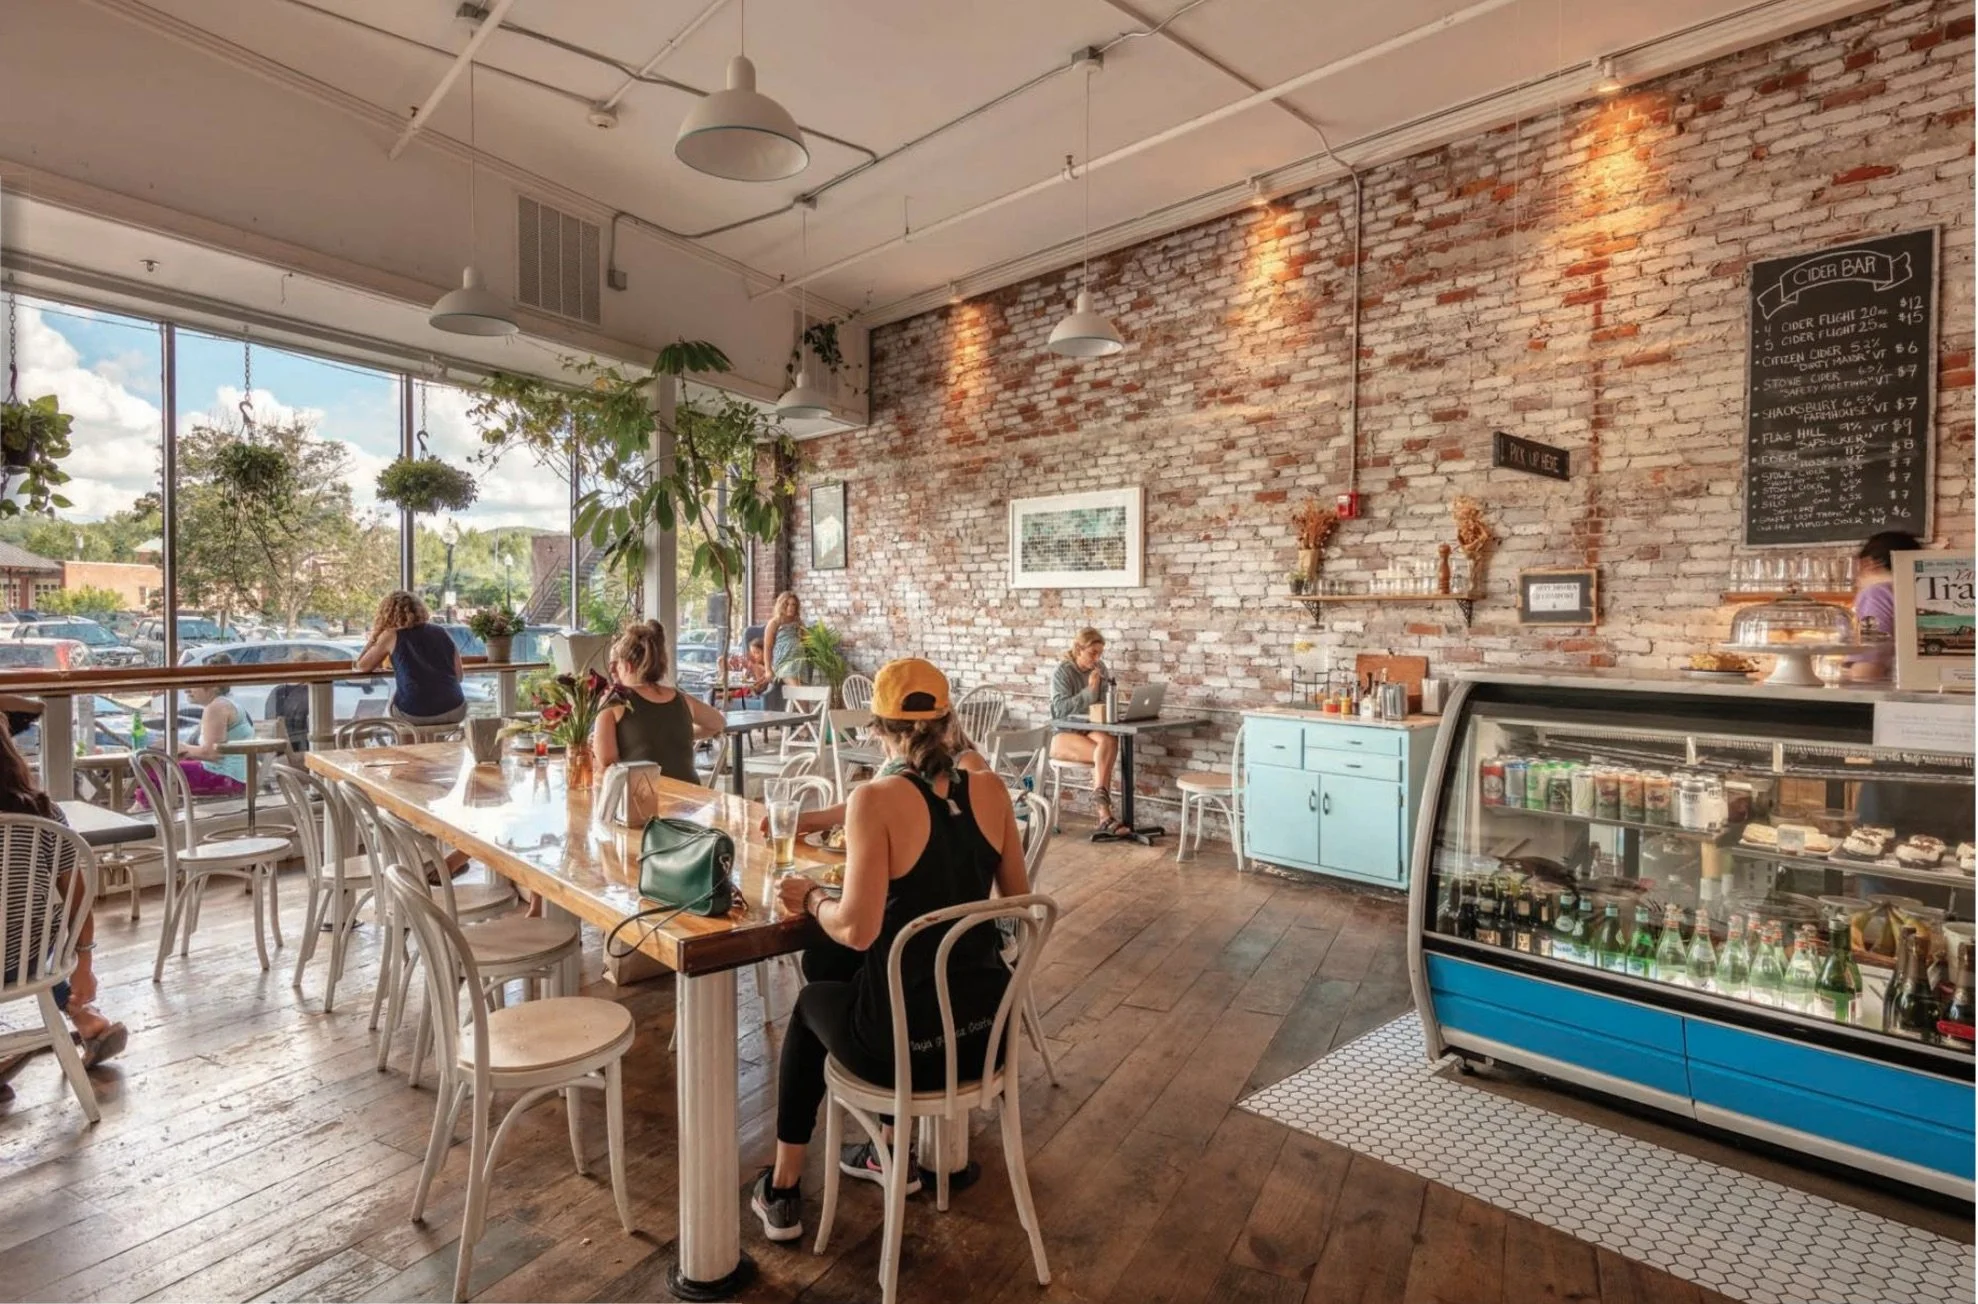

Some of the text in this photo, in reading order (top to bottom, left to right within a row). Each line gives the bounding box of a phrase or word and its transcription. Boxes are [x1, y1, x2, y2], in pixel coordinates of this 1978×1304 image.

[1793, 255, 1877, 285] CIDER BAR
[1781, 317, 1814, 333] CIDER
[1818, 309, 1856, 326] FLIGHT
[1899, 295, 1924, 310] $12
[1764, 339, 1774, 352] 5
[1781, 331, 1815, 346] CIDER
[1818, 323, 1857, 339] FLIGHT
[1897, 310, 1924, 326] $15
[1762, 352, 1805, 368] CITIZEN
[1809, 345, 1842, 360] CIDER
[1895, 340, 1919, 354] $6
[1872, 349, 1888, 360] VT
[1763, 375, 1801, 391] STOWE
[1810, 371, 1841, 384] CIDER
[1897, 364, 1918, 378] $7
[1875, 373, 1893, 386] VT
[1762, 398, 1836, 421] SHACKSBURY
[1896, 397, 1918, 411] $7
[1873, 402, 1889, 413] VT
[1762, 432, 1792, 446] FLAG
[1797, 427, 1826, 440] HILL
[1871, 423, 1888, 433] VT
[1892, 417, 1913, 435] $9
[1889, 439, 1914, 454] $8
[1528, 449, 1540, 470] UP
[1541, 451, 1560, 474] HERE
[1891, 505, 1912, 518] $6
